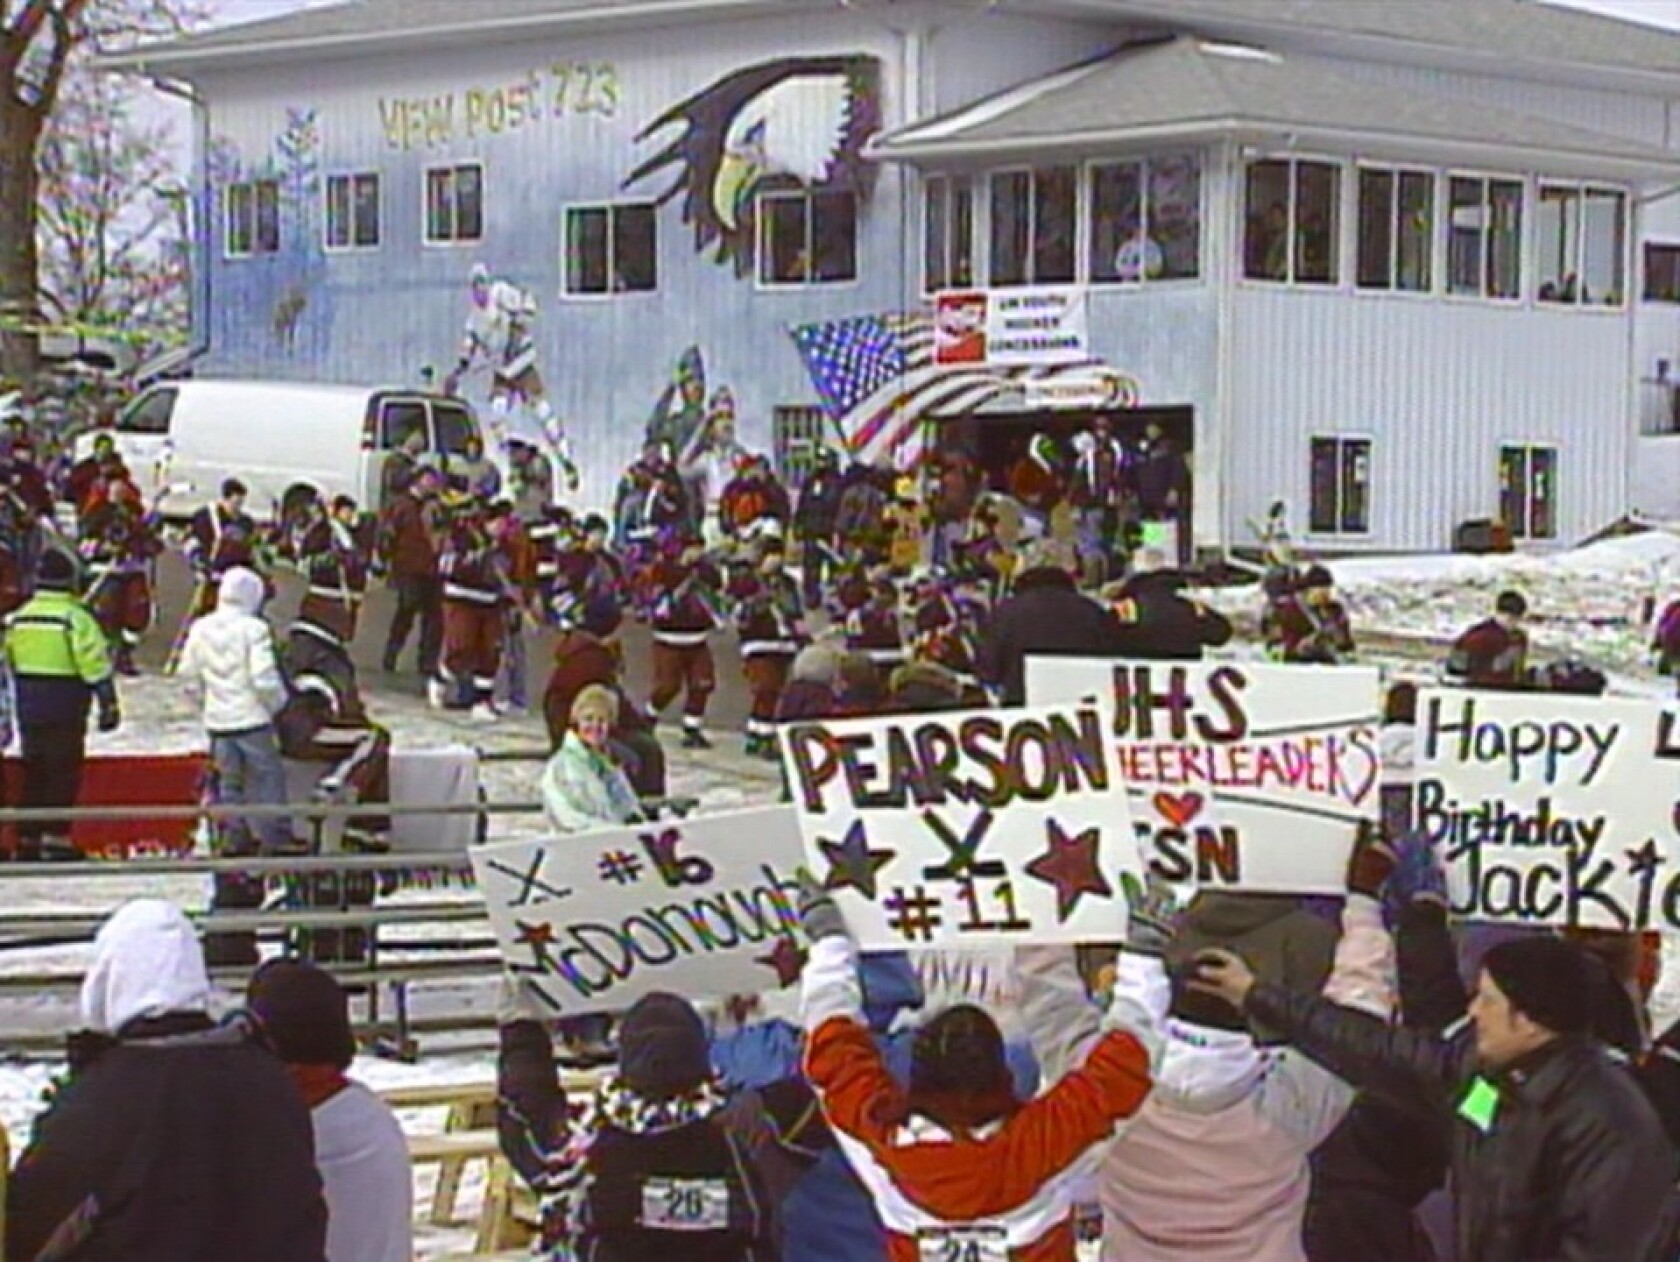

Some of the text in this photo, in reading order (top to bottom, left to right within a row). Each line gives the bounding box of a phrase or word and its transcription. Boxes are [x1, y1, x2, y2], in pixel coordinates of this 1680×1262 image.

[551, 57, 621, 117] 723
[788, 709, 1109, 814] PEARSON
[1425, 696, 1620, 786] Happy
[597, 827, 714, 888] #16
[1418, 779, 1605, 873] Birthday
[883, 876, 1032, 941] #11
